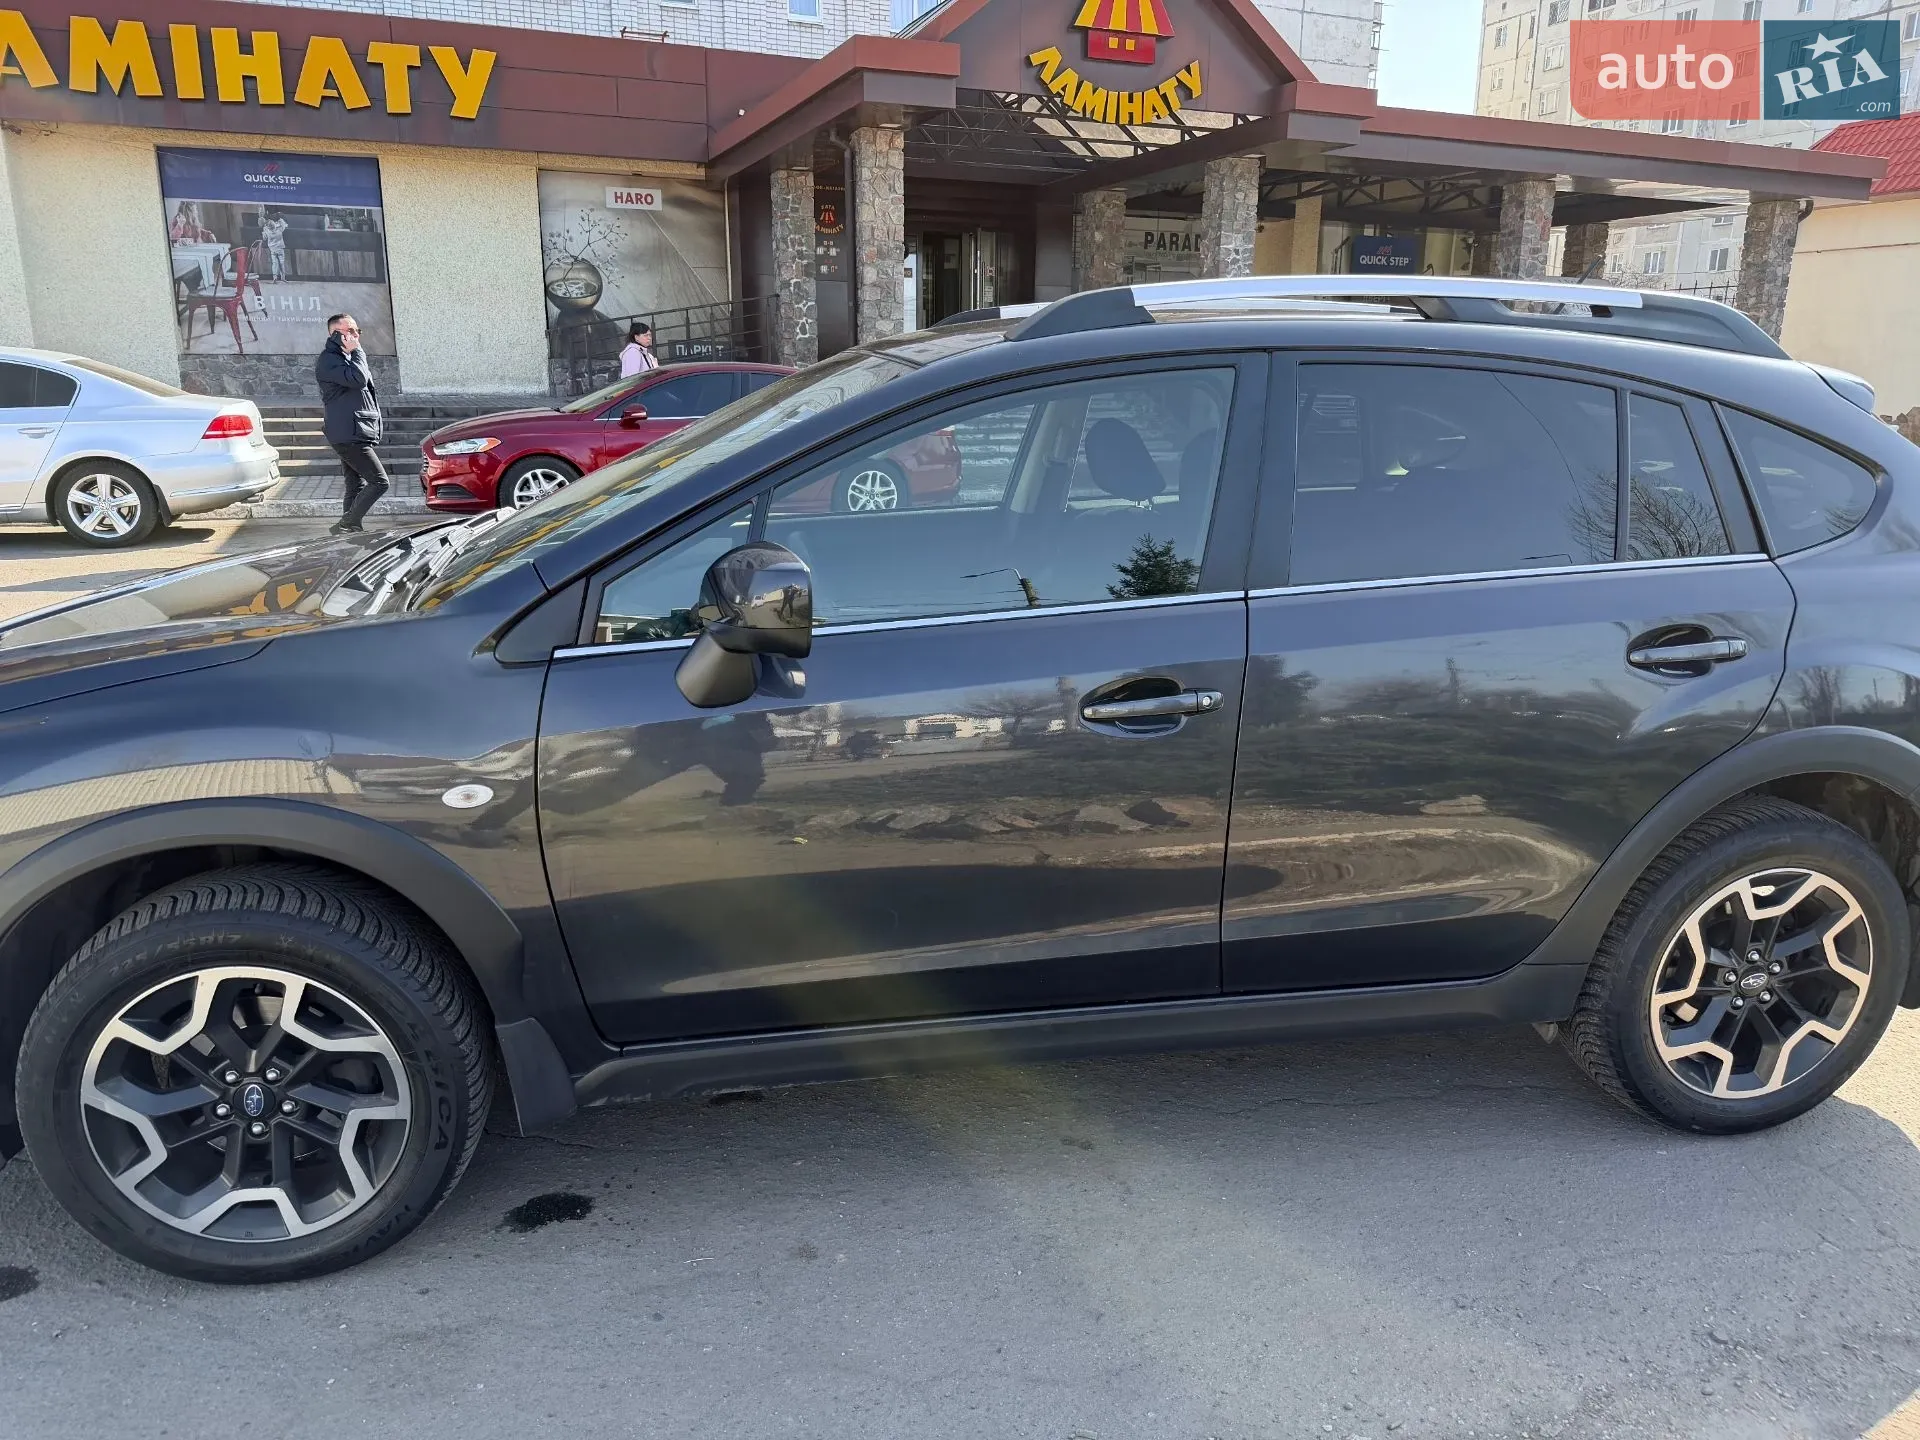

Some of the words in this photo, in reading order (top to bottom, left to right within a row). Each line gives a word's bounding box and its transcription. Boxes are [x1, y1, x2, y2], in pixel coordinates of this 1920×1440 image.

[1029, 46, 1202, 125] ЛАМІНАТУ
[614, 191, 655, 206] HARO
[1359, 255, 1387, 265] QUICK
[1389, 255, 1409, 267] STEP
[254, 295, 321, 312] ВІНІЛ
